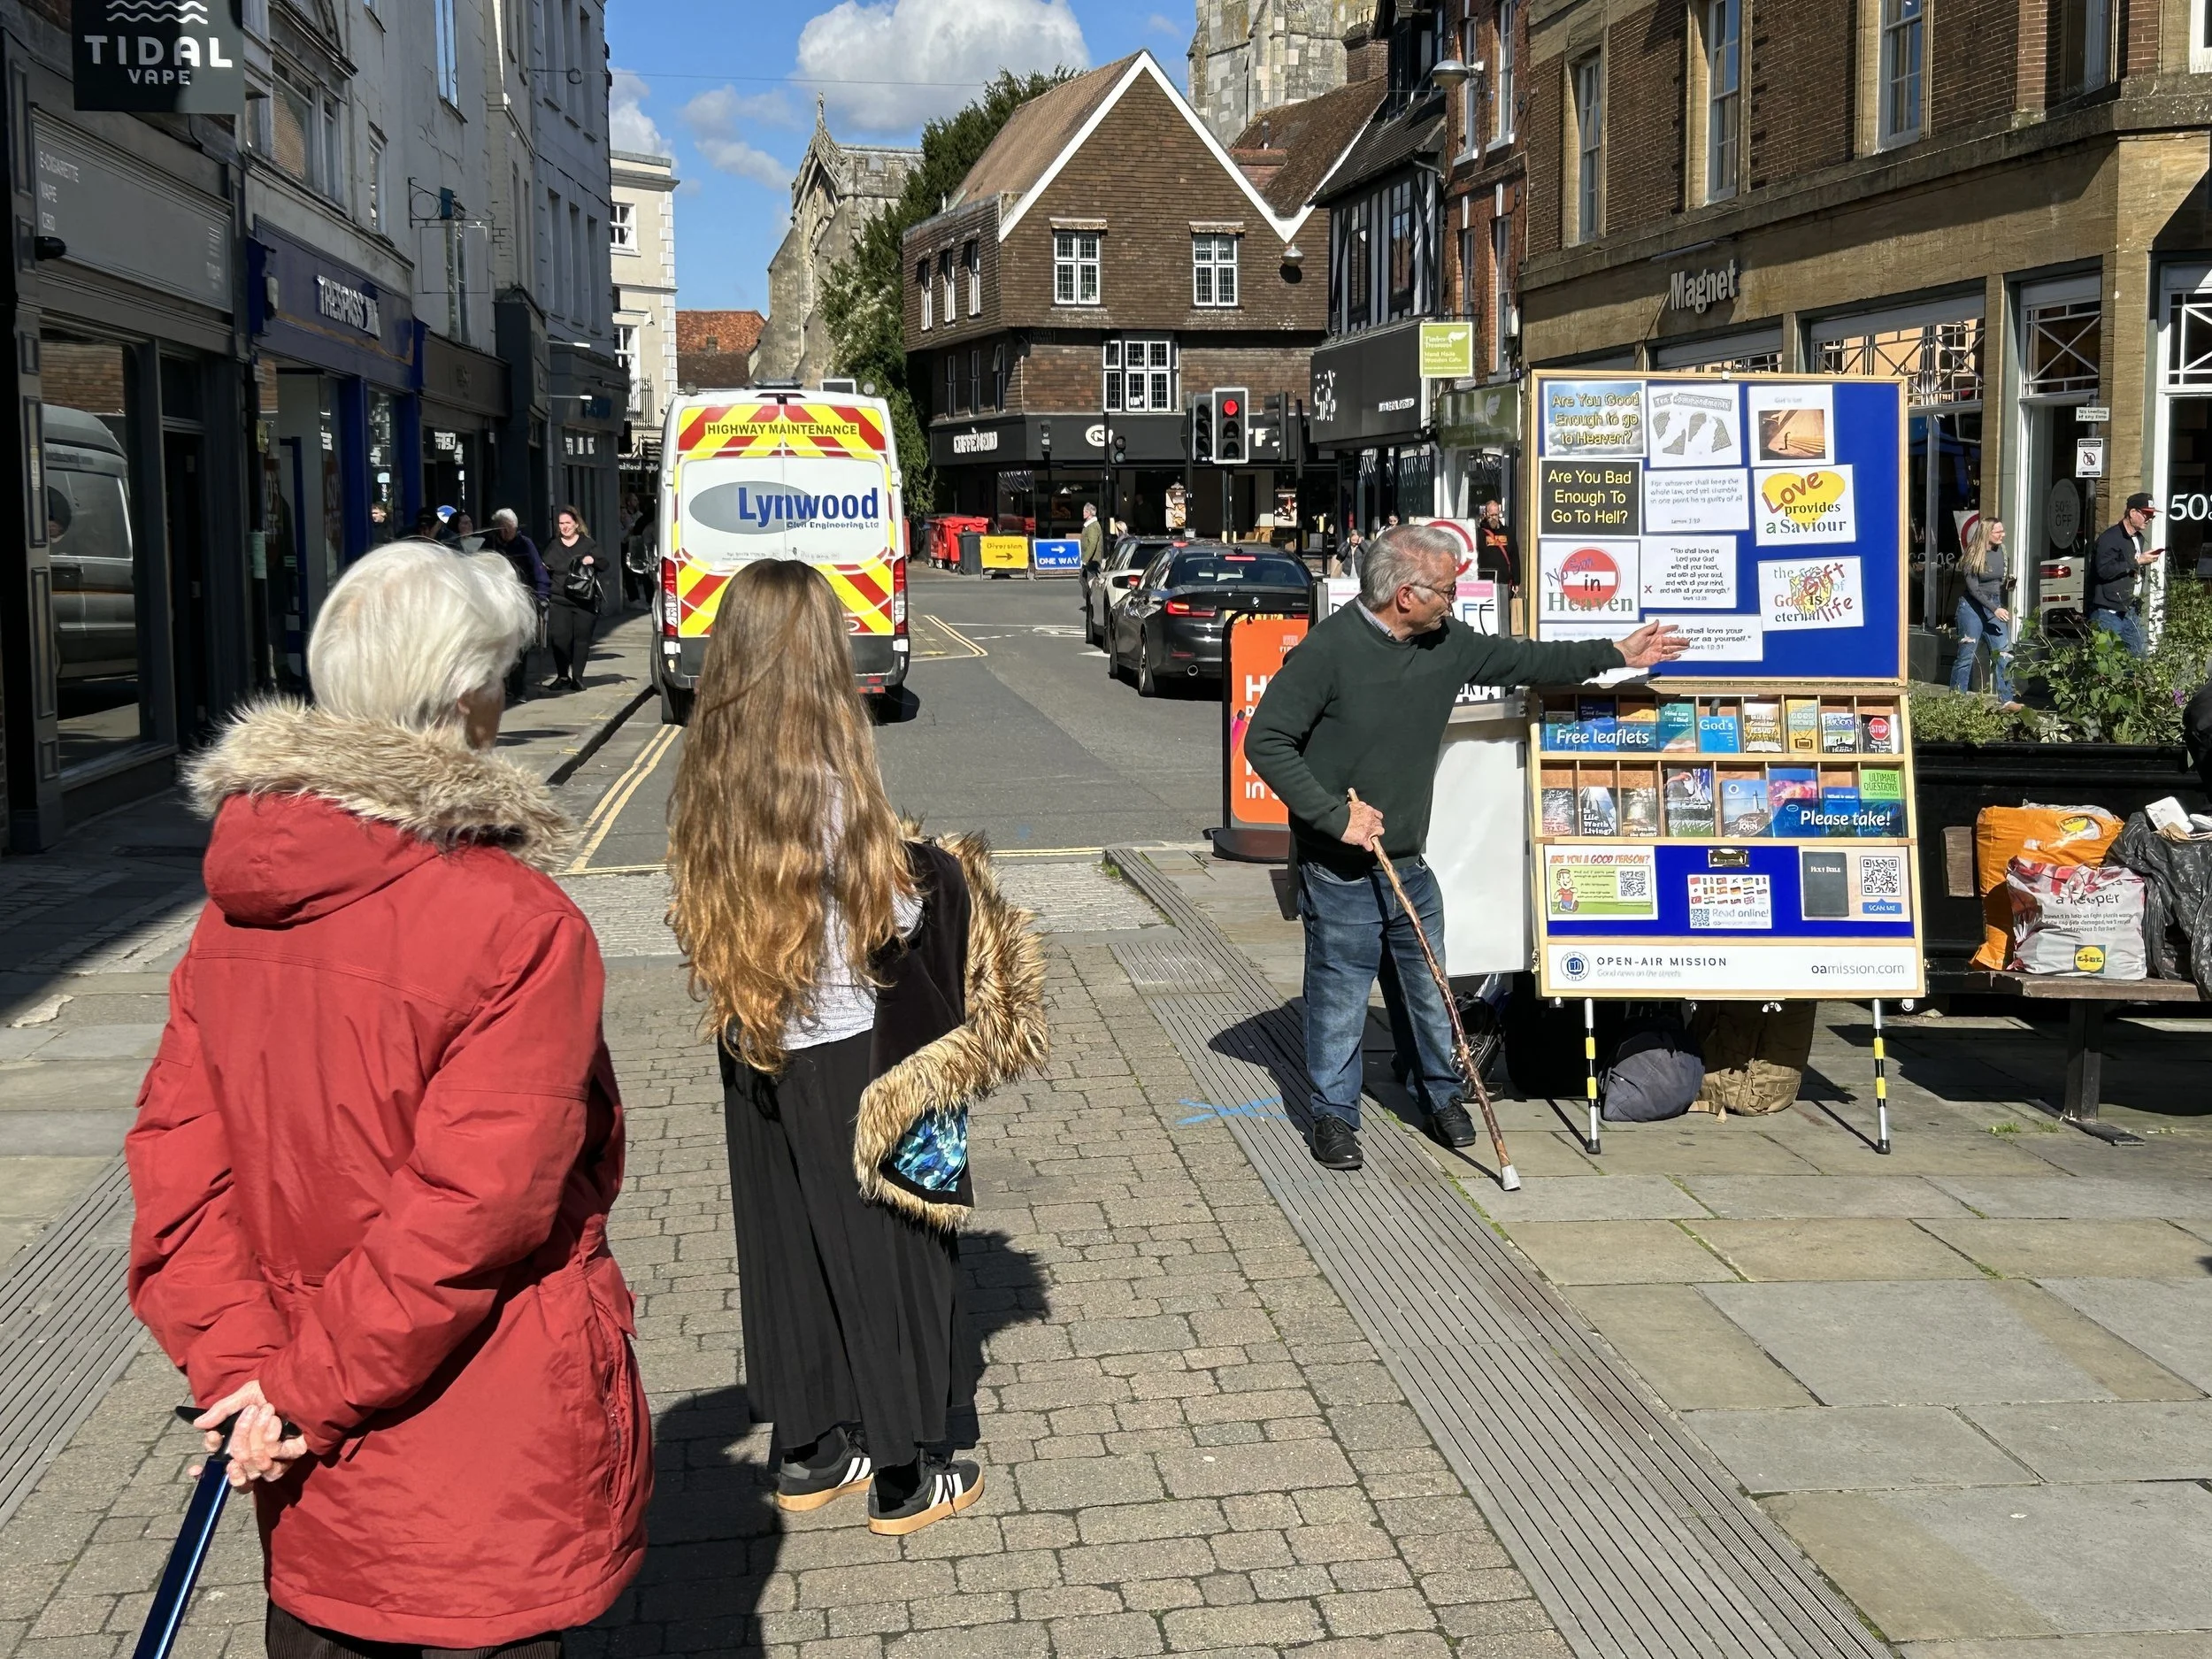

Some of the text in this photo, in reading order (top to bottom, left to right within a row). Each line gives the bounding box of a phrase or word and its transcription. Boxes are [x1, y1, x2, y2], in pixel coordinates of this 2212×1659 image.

[84, 35, 233, 68] TIDAL
[127, 68, 191, 85] VAPE
[1671, 258, 1736, 314] Magnet
[1552, 392, 1640, 408] Are You Good
[1555, 412, 1640, 427] Enough to go
[707, 424, 857, 435] HIGHWAY MAINTENANCE
[1561, 430, 1633, 445] to Heaven?
[1548, 470, 1632, 484] Are You Bad
[1555, 489, 1626, 506] Enough To
[1762, 472, 1824, 514] Love
[738, 487, 879, 528] Lynwood
[1784, 501, 1841, 518] provides
[1551, 510, 1628, 524] Go To Hell?
[2055, 513, 2073, 527] OFF
[810, 521, 864, 530] Engineering
[1766, 518, 1847, 534] a Saviour
[1546, 568, 1569, 587] No
[1584, 573, 1601, 592] in
[1773, 566, 1794, 579] the
[1832, 581, 1846, 592] of
[1548, 591, 1633, 612] Heaven
[1775, 592, 1823, 607] God is
[1775, 596, 1854, 624] eternal life
[1699, 719, 1734, 730] God's
[1870, 725, 1887, 733] STOP
[1555, 726, 1649, 745] Free leaflets
[1868, 772, 1897, 783] ULTIMATE
[1863, 782, 1898, 792] QUESTIONS
[1801, 810, 1891, 826] Please take!
[1738, 822, 1758, 831] JOHN
[1549, 854, 1651, 864] ARE YOU A GOOD PERSON?
[1712, 908, 1769, 918] Read online!
[1596, 956, 1727, 966] OPEN-AIR MISSION
[1811, 963, 1905, 974] oamission.com
